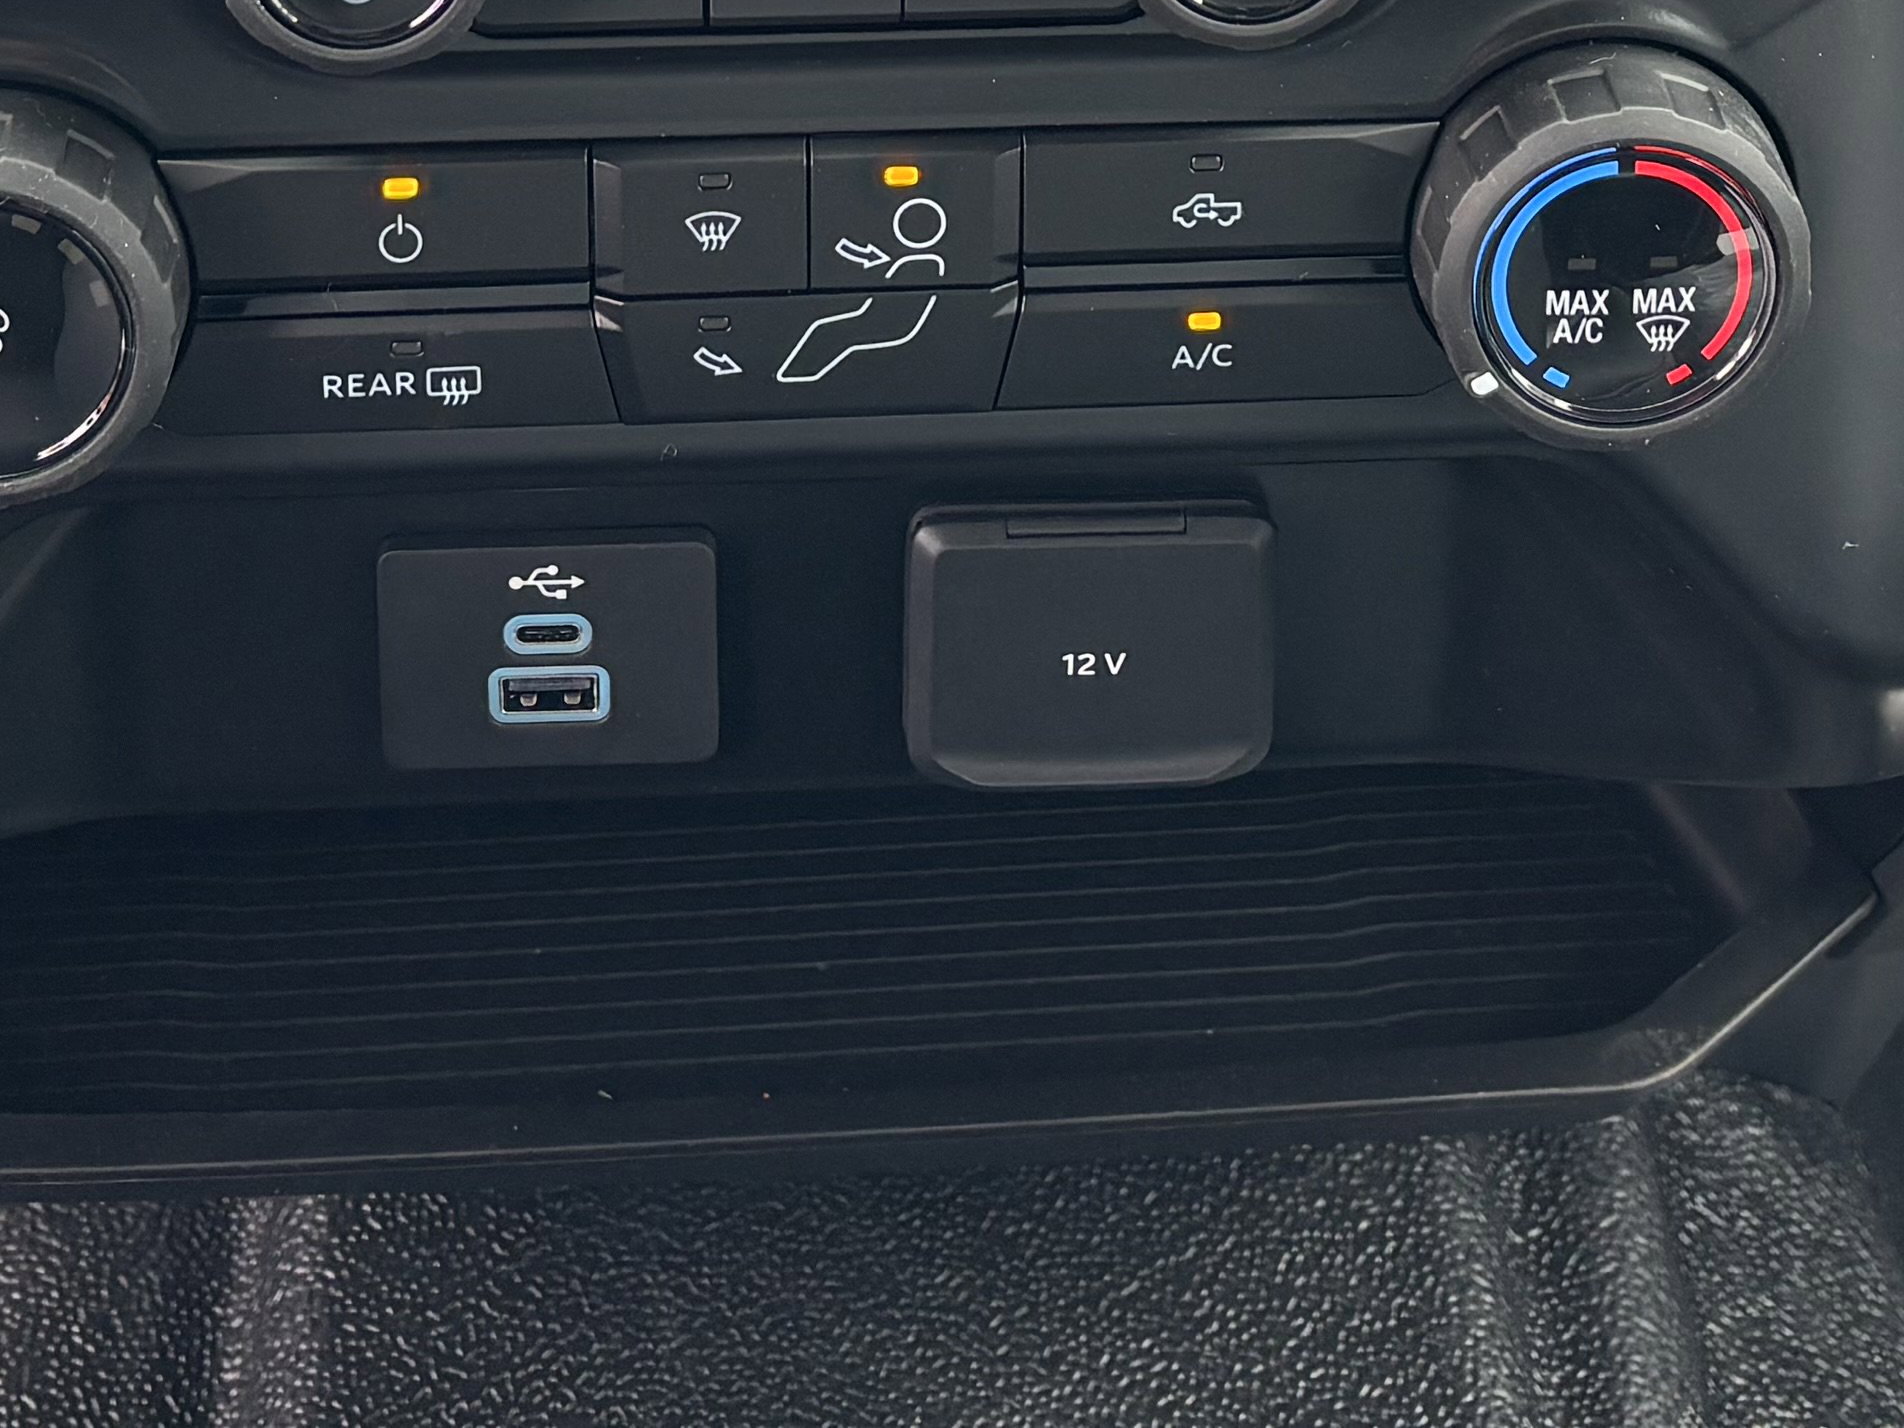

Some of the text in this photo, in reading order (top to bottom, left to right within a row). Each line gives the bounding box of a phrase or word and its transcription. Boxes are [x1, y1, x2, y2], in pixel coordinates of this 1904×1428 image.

[1545, 286, 1696, 316] MAX MAX
[1552, 317, 1604, 344] A/C
[1171, 342, 1232, 370] A/C
[322, 371, 416, 398] REAR
[1062, 652, 1126, 676] 12 V
